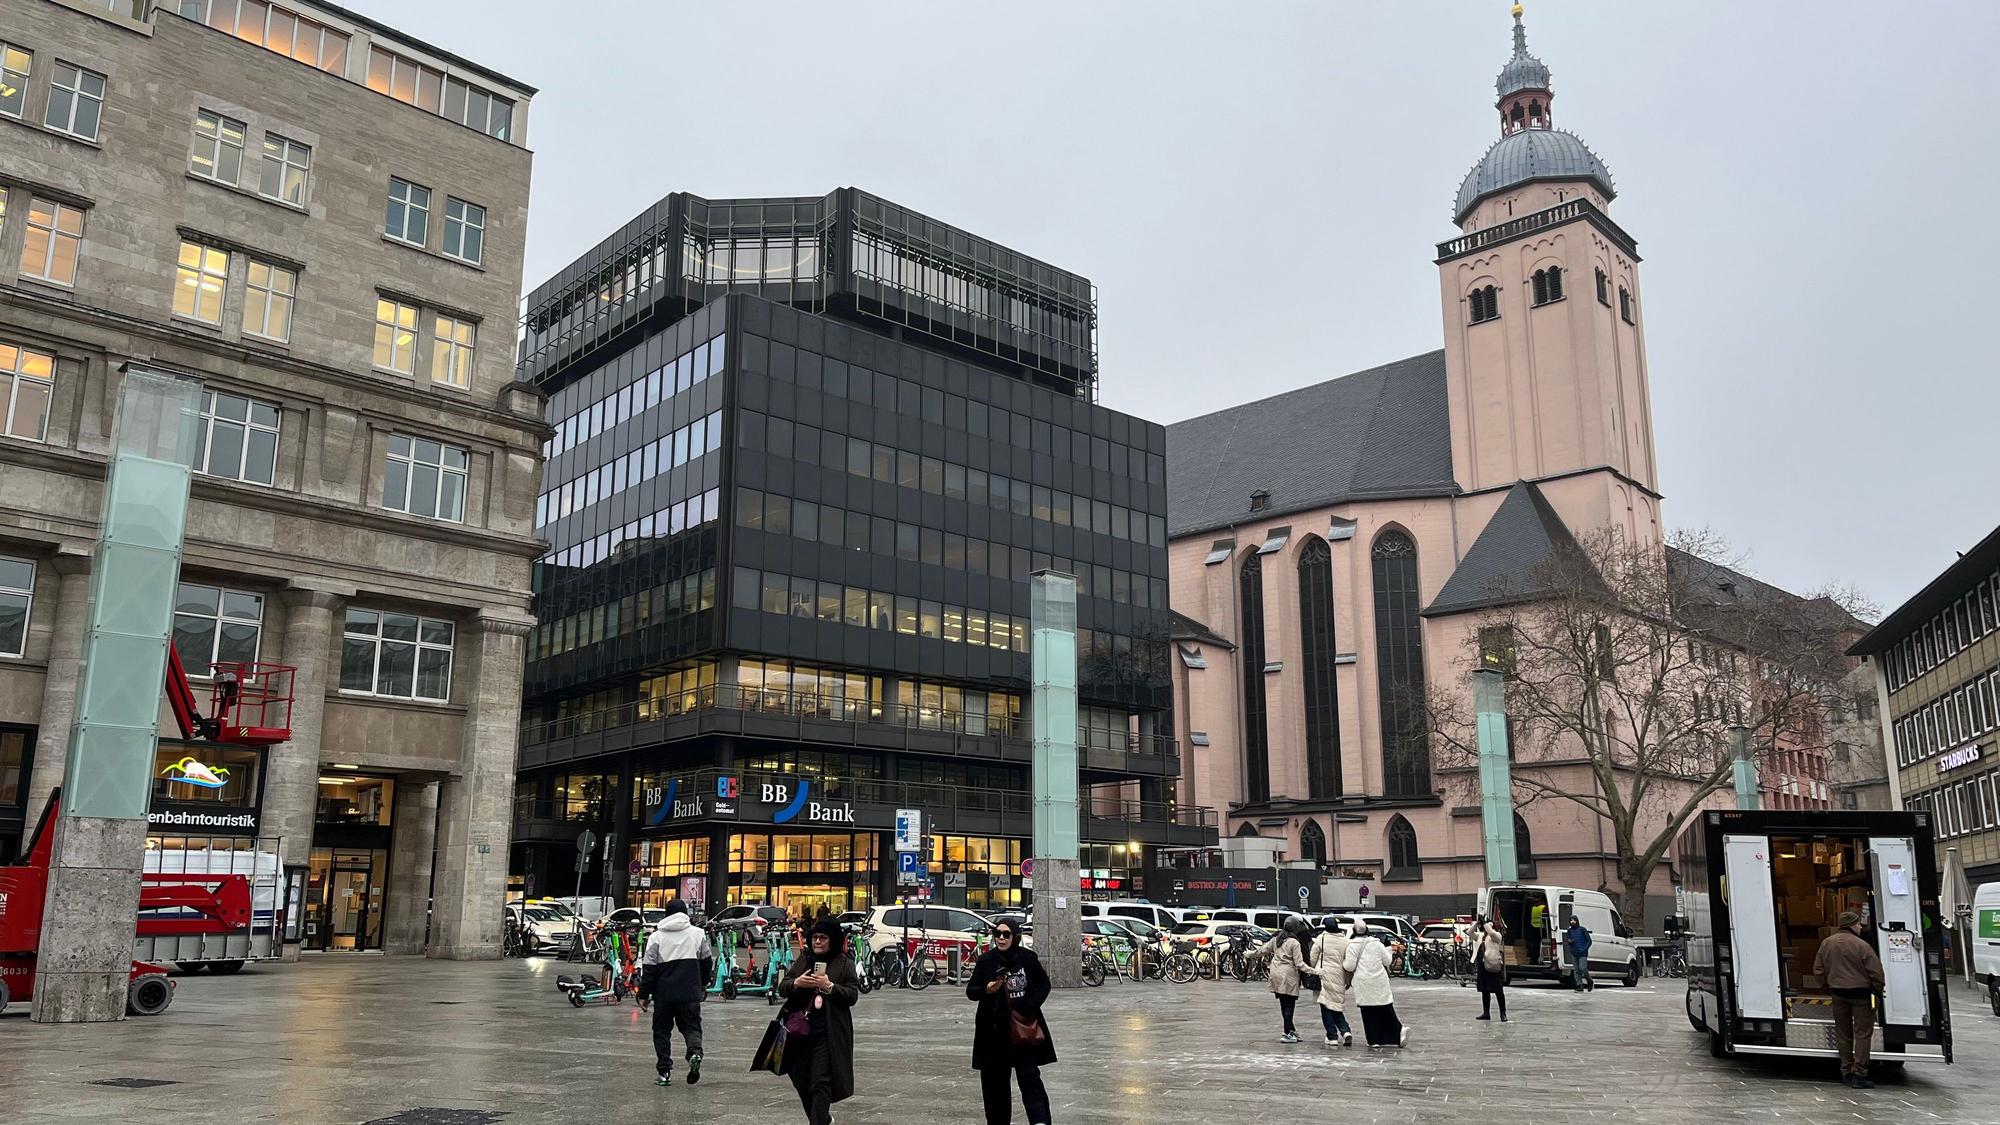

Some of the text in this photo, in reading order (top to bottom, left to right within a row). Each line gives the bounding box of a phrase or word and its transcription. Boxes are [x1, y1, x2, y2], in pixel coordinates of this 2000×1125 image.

[1940, 744, 1979, 772] STARBUCKS
[646, 787, 703, 818] BB Bank
[761, 783, 855, 822] BB Bank
[148, 810, 255, 827] enbahntouristik
[903, 854, 913, 871] P
[1095, 879, 1106, 889] AM
[1187, 880, 1216, 890] BISTRO
